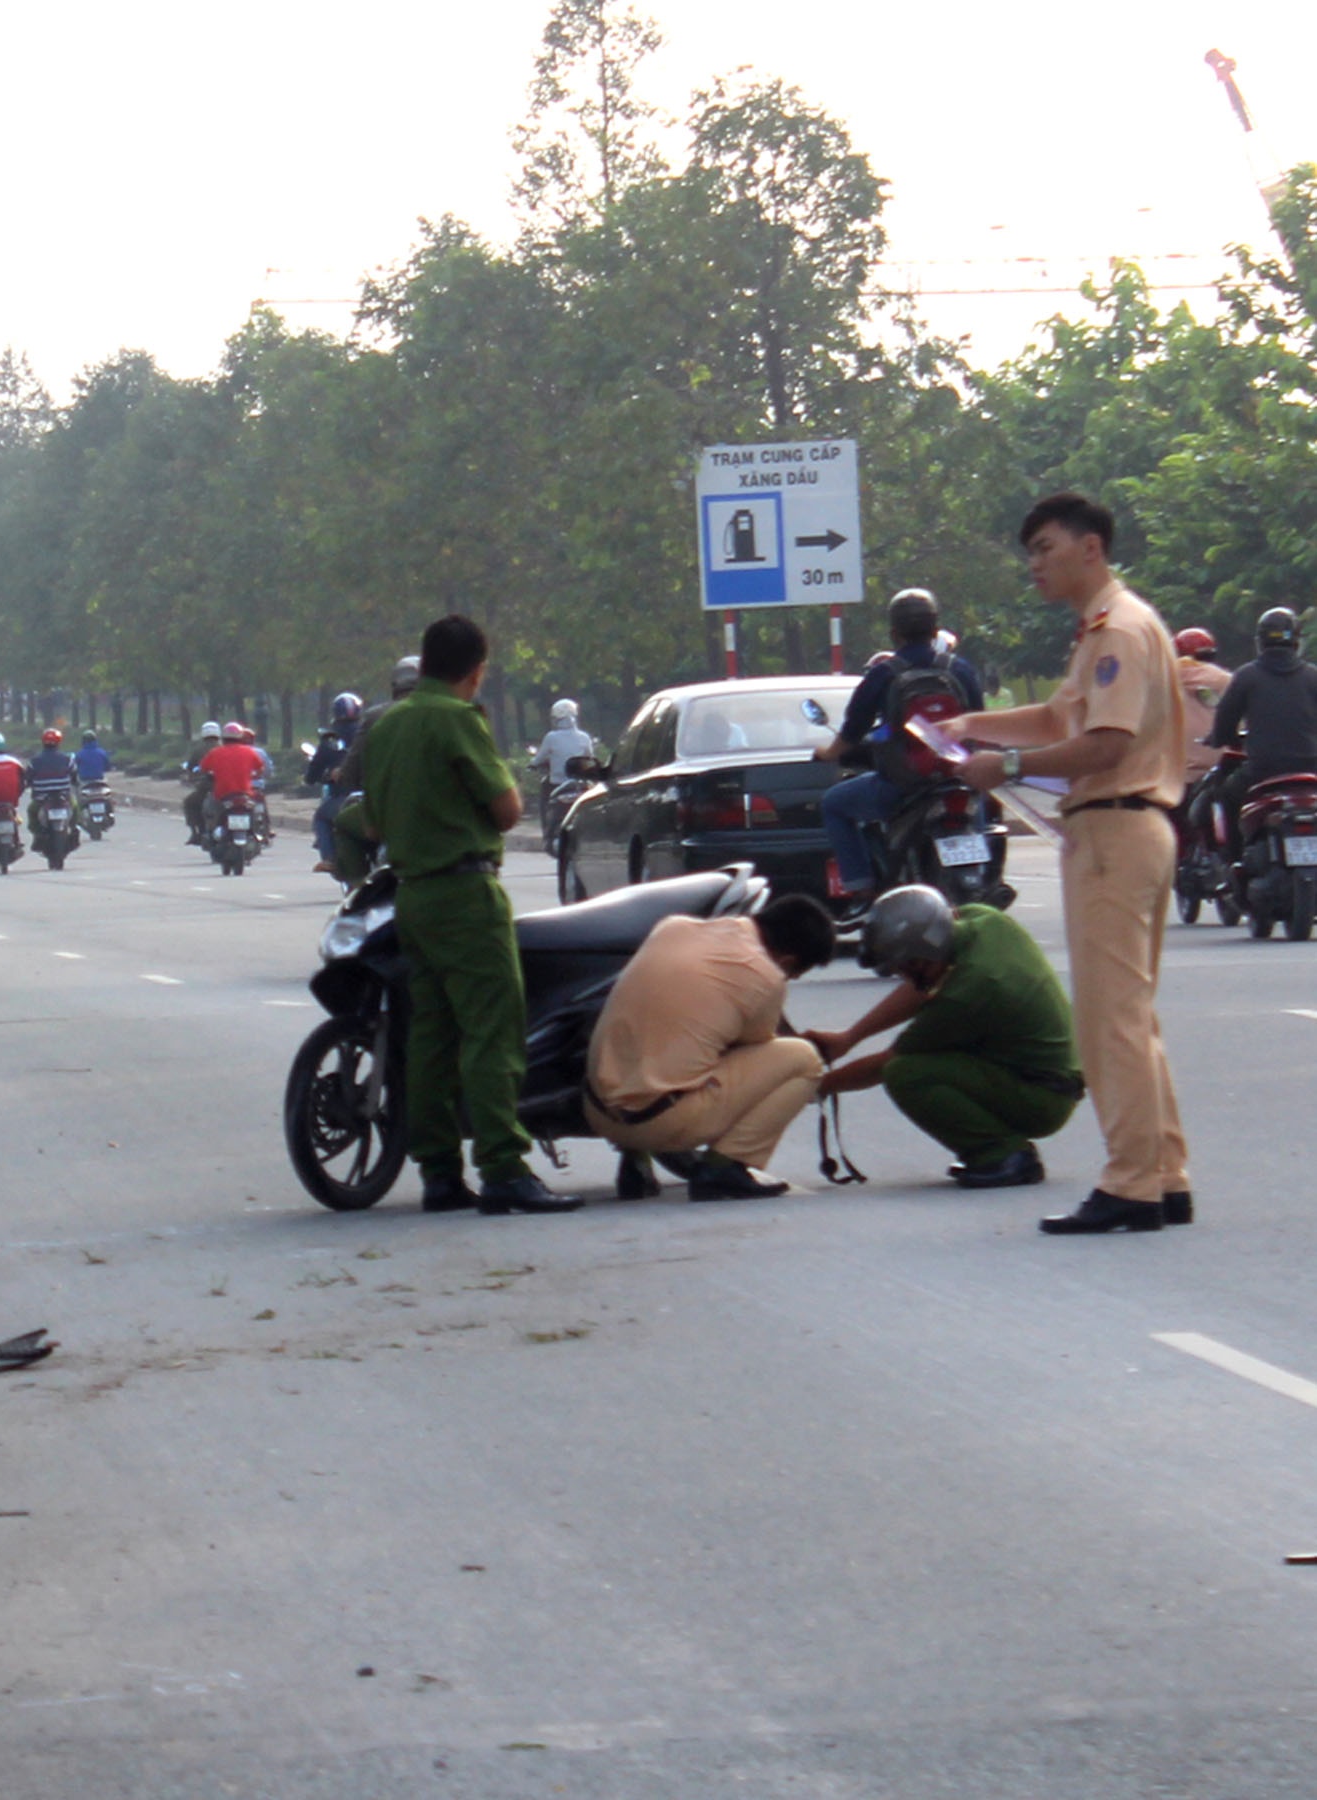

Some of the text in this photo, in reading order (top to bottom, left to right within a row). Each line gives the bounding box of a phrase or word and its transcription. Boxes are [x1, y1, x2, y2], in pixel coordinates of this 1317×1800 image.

[710, 443, 842, 469] TRẠM CUNG CẤP
[801, 569, 845, 586] 30 m
